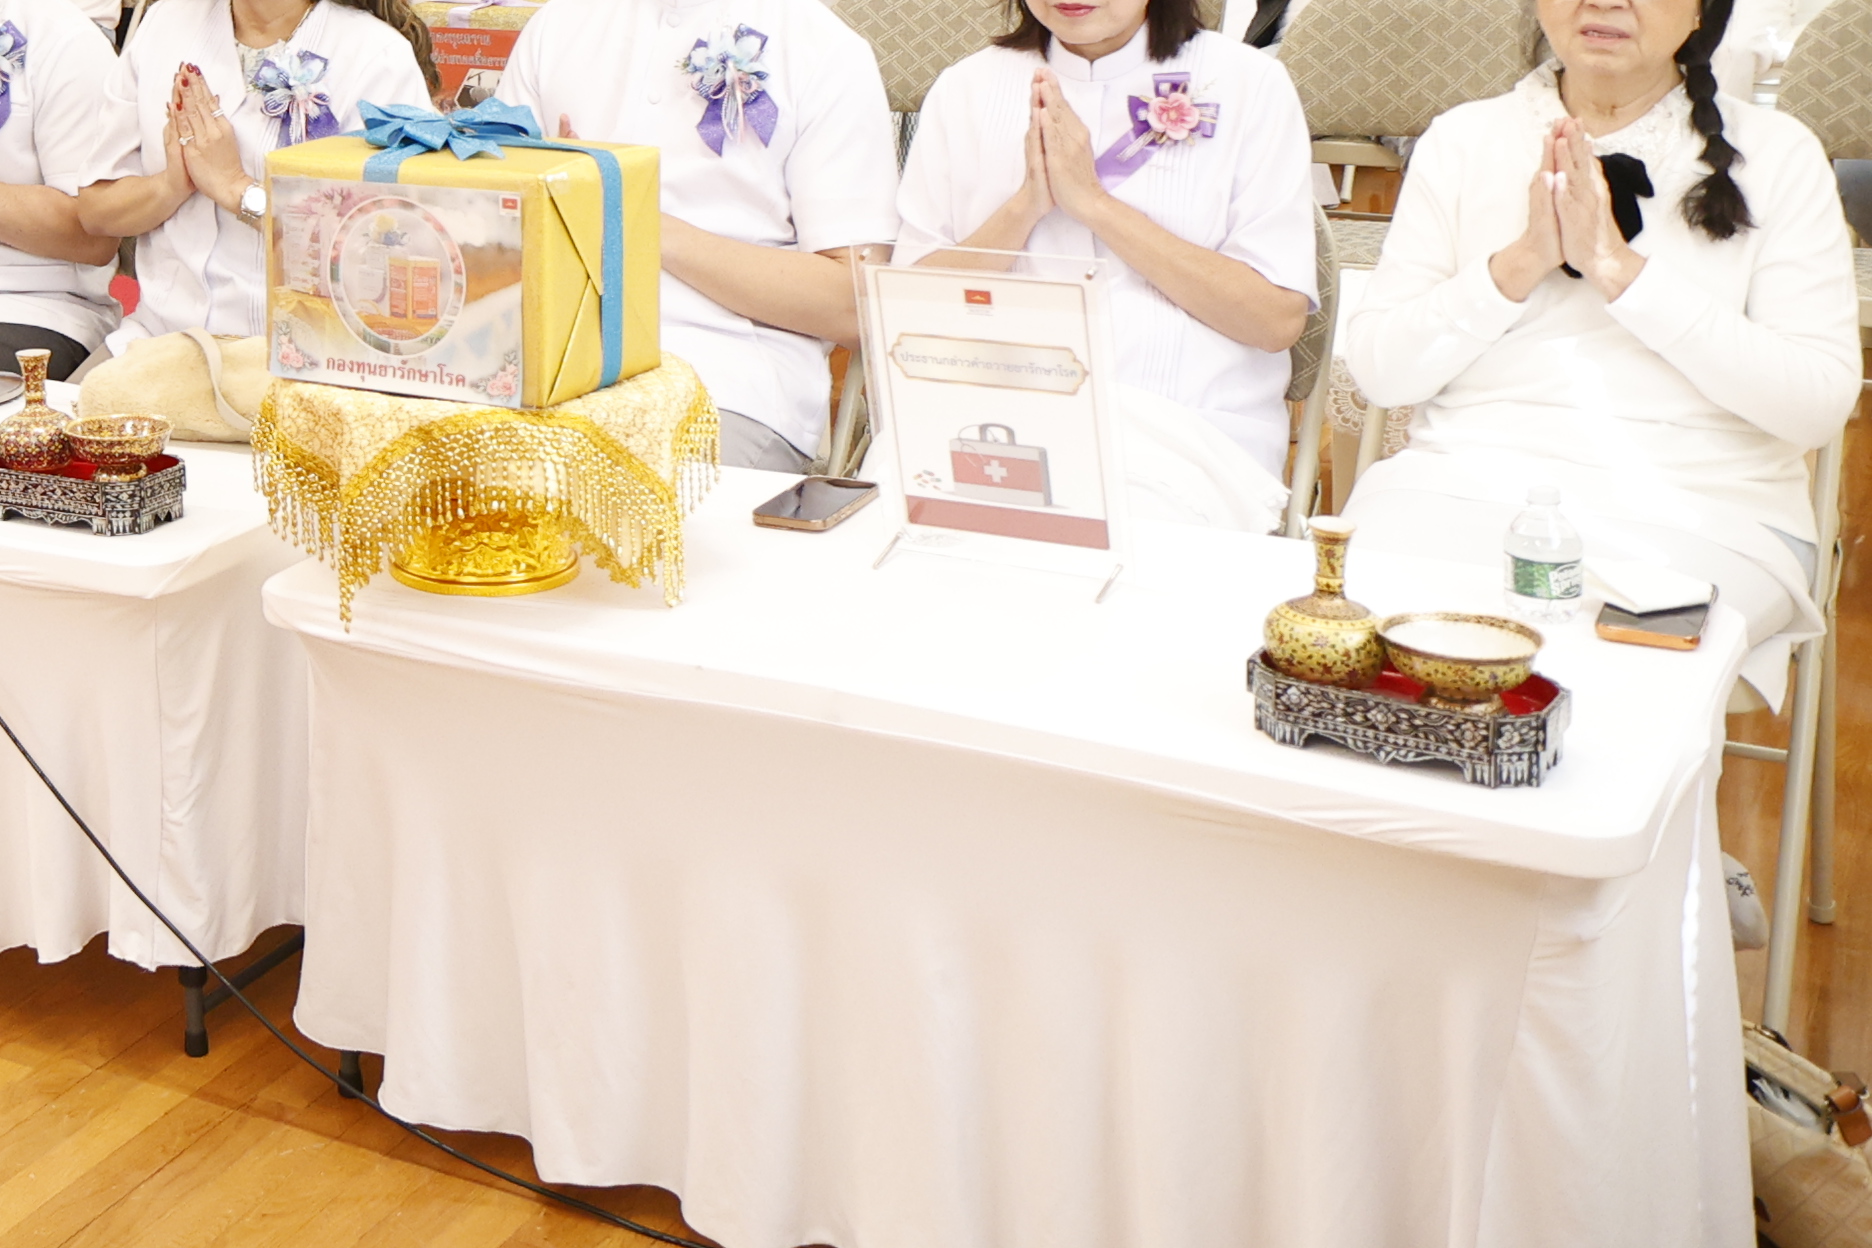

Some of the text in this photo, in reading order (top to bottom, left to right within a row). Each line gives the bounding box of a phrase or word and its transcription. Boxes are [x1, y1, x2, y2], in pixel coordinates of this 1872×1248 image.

[326, 356, 466, 388] กองทุนยารักษาโรค
